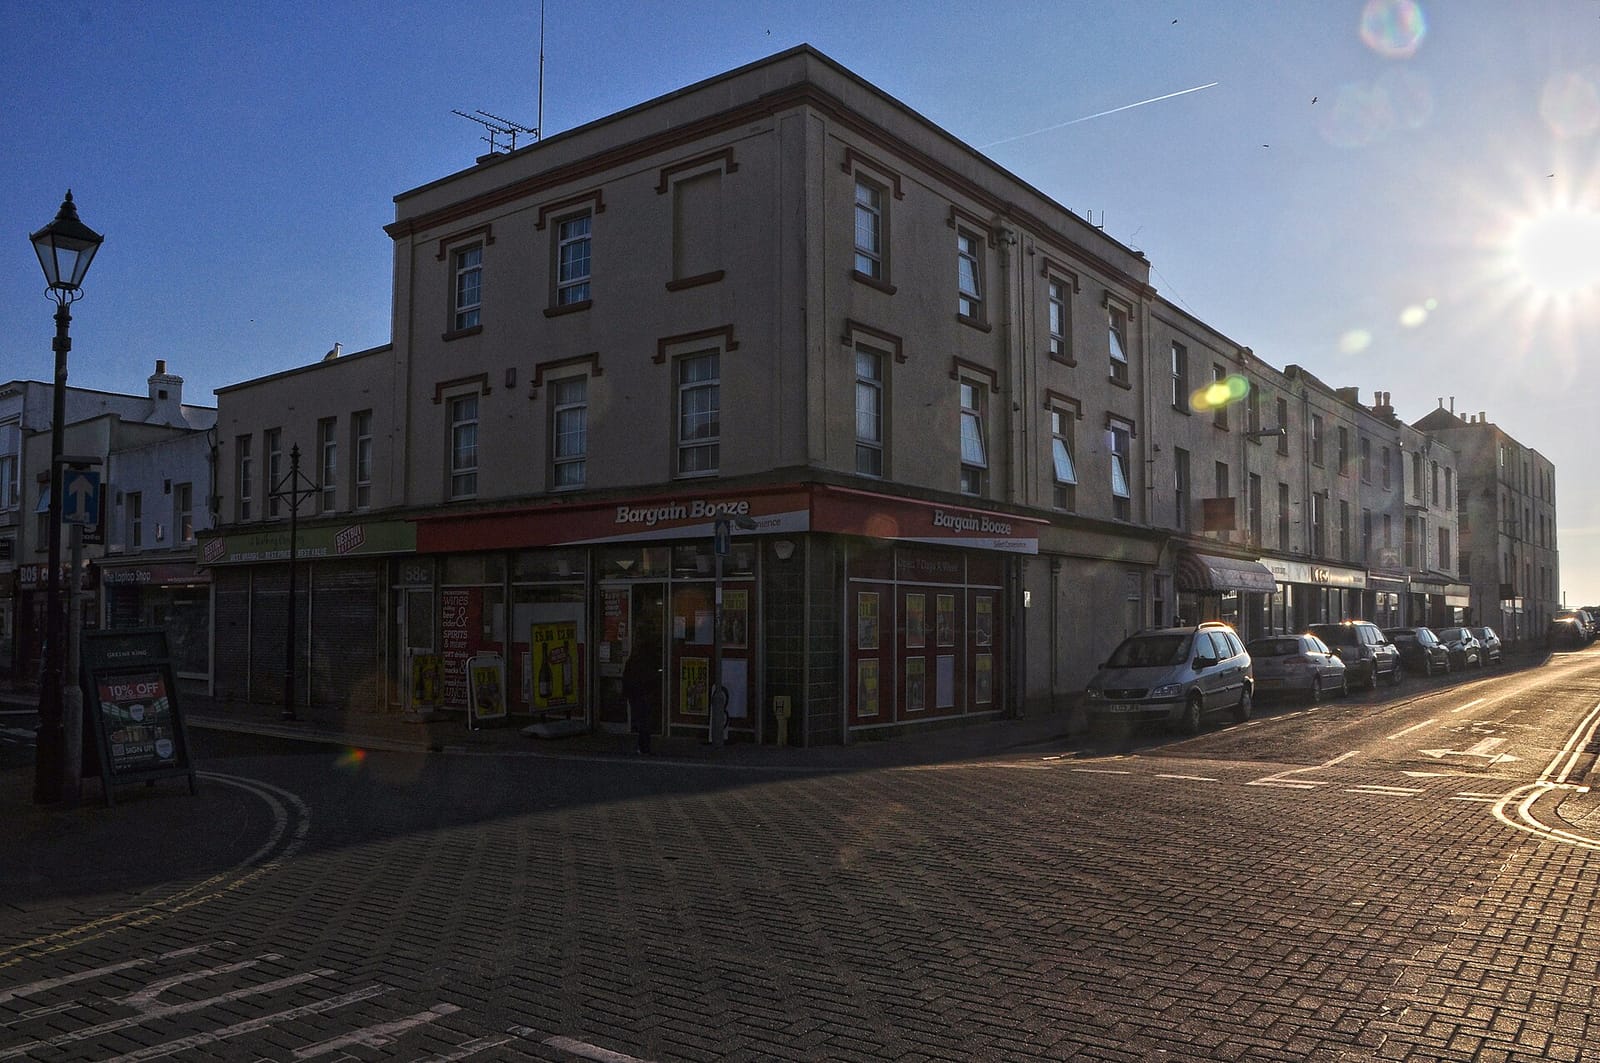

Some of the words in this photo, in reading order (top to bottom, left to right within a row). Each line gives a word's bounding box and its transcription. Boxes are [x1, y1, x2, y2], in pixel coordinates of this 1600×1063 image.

[615, 502, 687, 526] Bargain
[689, 499, 749, 518] Booze
[933, 509, 979, 532] Bargain
[981, 516, 1012, 535] Booze
[115, 571, 135, 585] Laptop
[136, 569, 151, 584] Shop
[443, 630, 468, 639] SPIRITS
[108, 684, 133, 697] 10%
[136, 682, 160, 695] OFF
[775, 700, 785, 713] H
